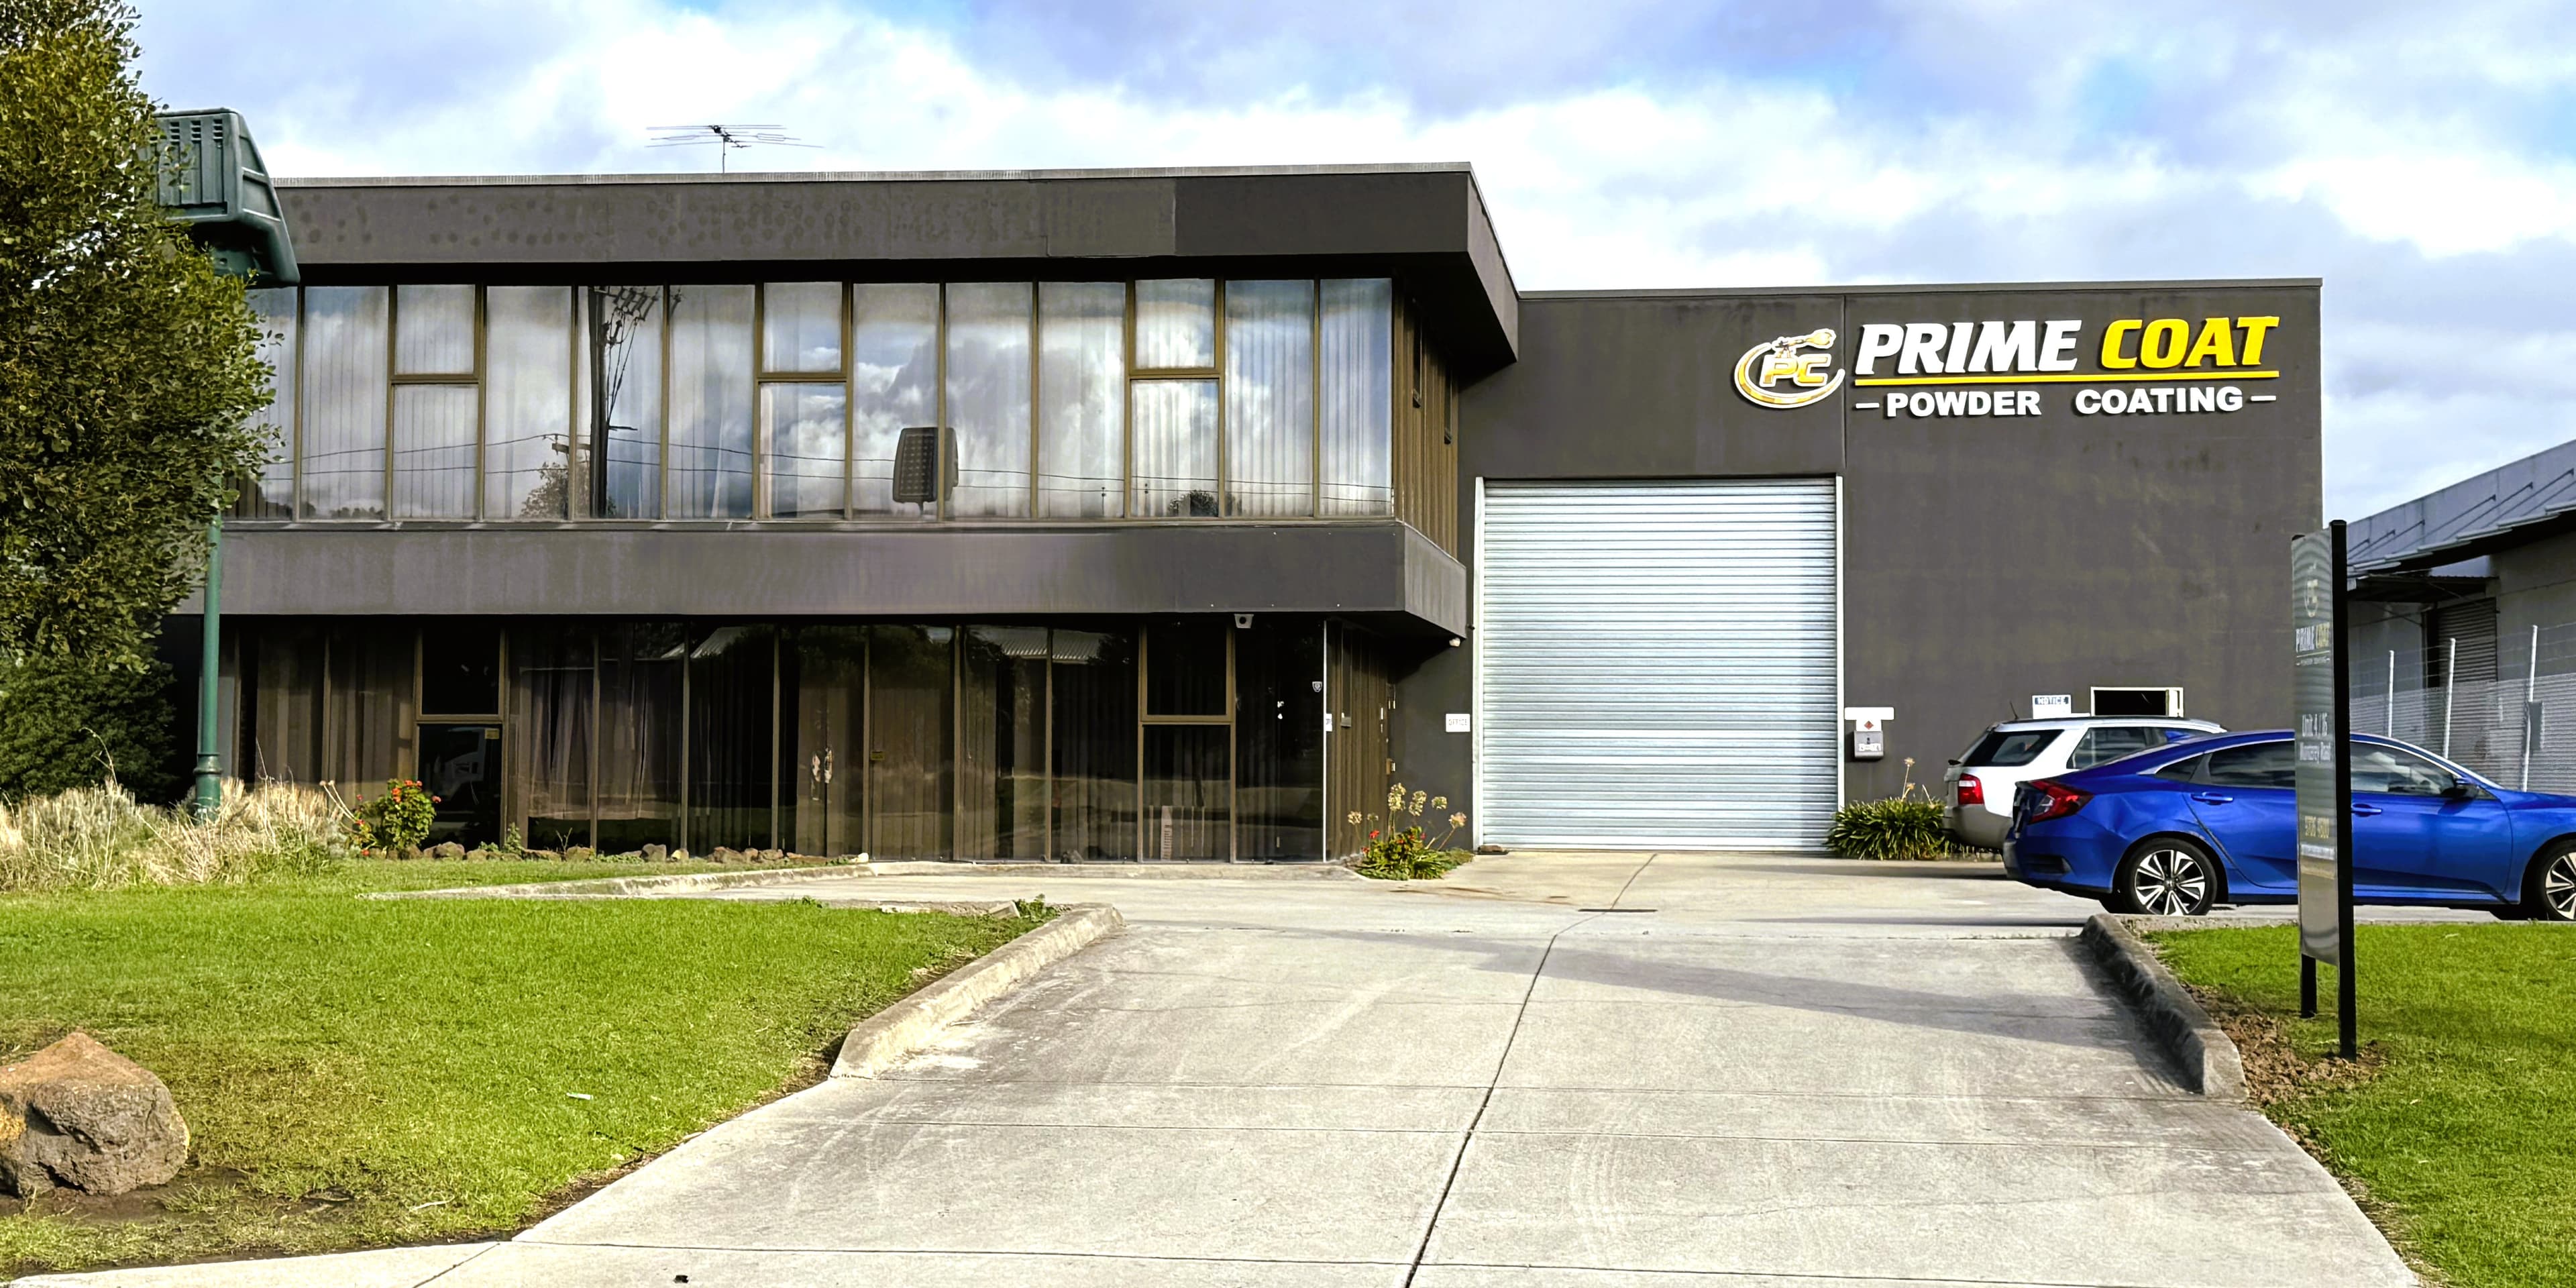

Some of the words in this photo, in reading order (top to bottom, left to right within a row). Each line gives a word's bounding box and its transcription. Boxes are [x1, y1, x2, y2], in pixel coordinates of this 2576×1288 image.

[1856, 320, 2082, 374] PRIME
[2102, 317, 2279, 369] COAT
[1760, 354, 1831, 387] PC
[1888, 391, 2041, 417] POWDER
[2076, 386, 2243, 414] COATING
[2038, 696, 2065, 705] NOTICE
